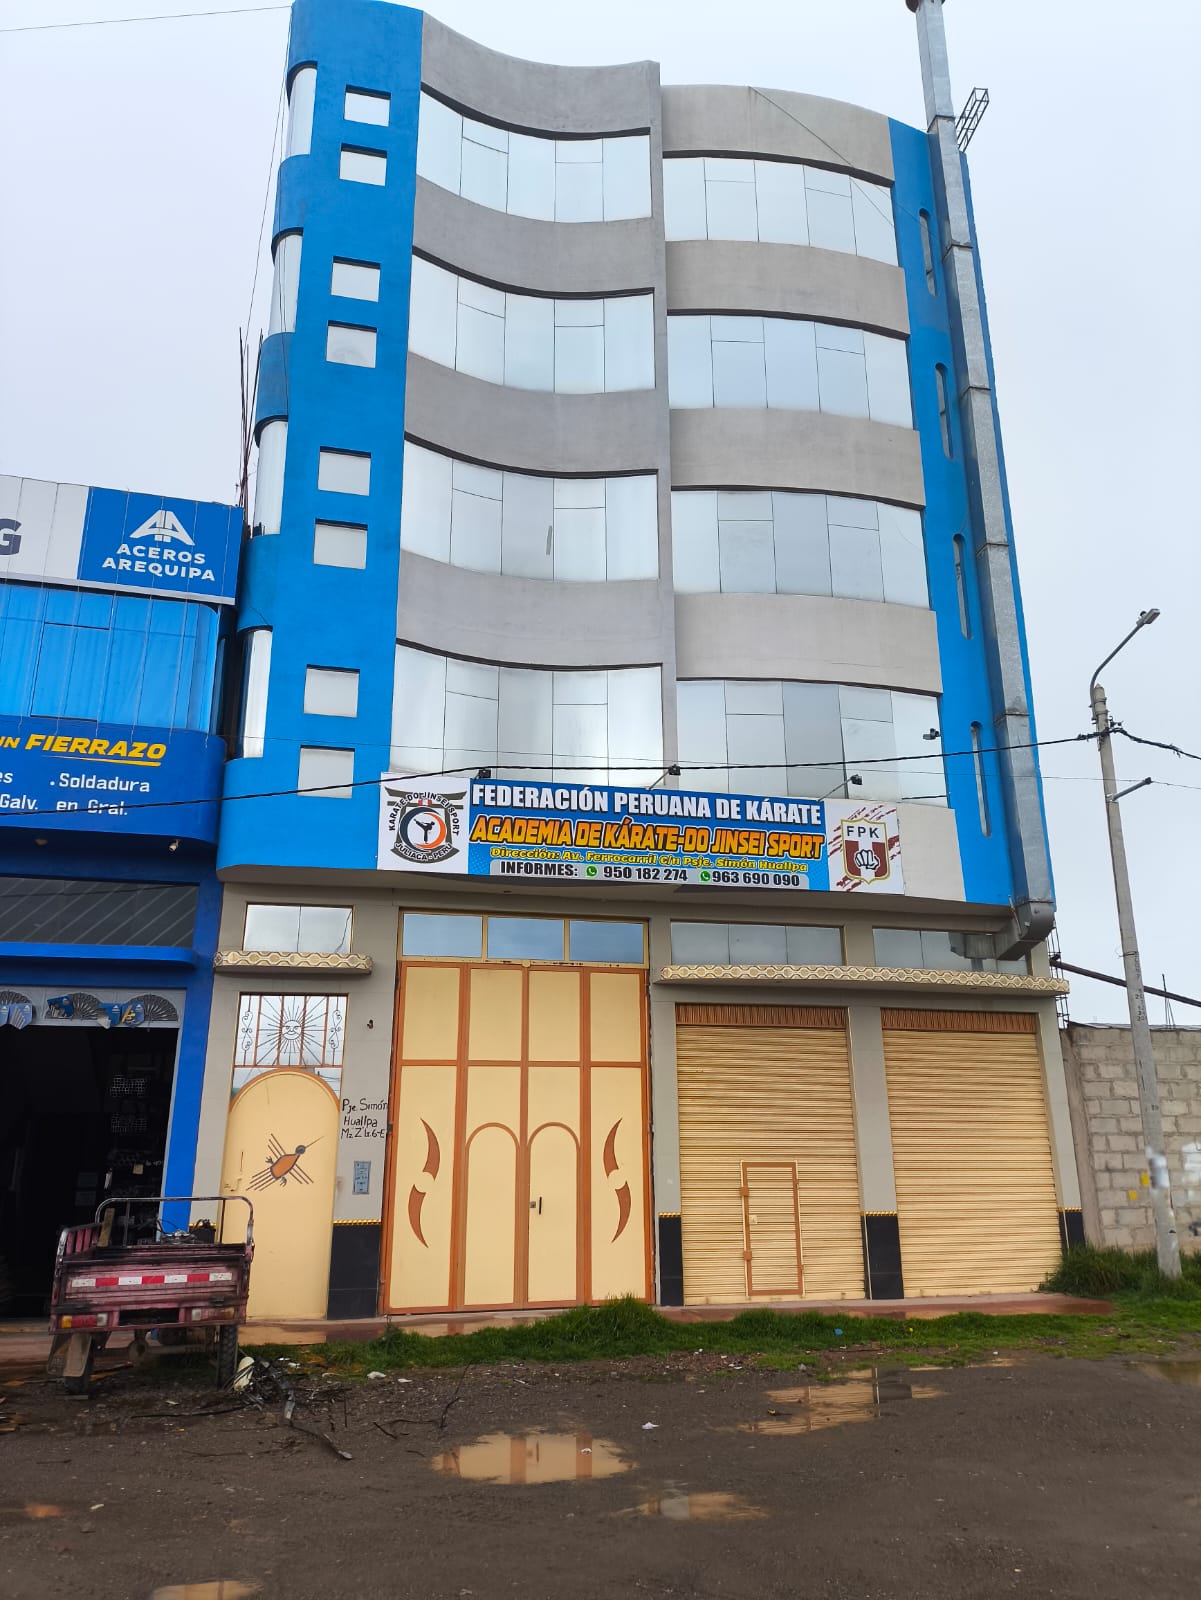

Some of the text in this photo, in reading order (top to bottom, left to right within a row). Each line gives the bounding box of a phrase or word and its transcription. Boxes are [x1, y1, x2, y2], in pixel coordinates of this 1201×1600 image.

[117, 543, 206, 565] ACEROS
[102, 557, 215, 582] AREQUIPA
[25, 733, 167, 760] FIERRAZO
[59, 773, 150, 793] Soldadura
[0, 793, 38, 811] Galv.
[56, 800, 78, 812] en
[472, 783, 822, 826] FEDERACIÓN PERUANA DE KÁRATE
[423, 791, 450, 809] JINSEI
[448, 806, 461, 837] SPORT
[470, 815, 826, 860] ACADEMIA DE KÁRATE-DO JINSEI SPORT
[846, 825, 880, 839] FPK
[395, 842, 428, 861] JULIACA
[490, 845, 560, 861] Dirección:
[562, 850, 584, 863] Av.
[586, 852, 657, 866] Ferrocarril
[683, 857, 713, 870] Psje.
[716, 858, 756, 870] Simón
[758, 860, 808, 874] Huallpa
[500, 861, 800, 888] INFORMES: 950 182 274 963 690 090
[343, 1115, 378, 1129] Huallpa
